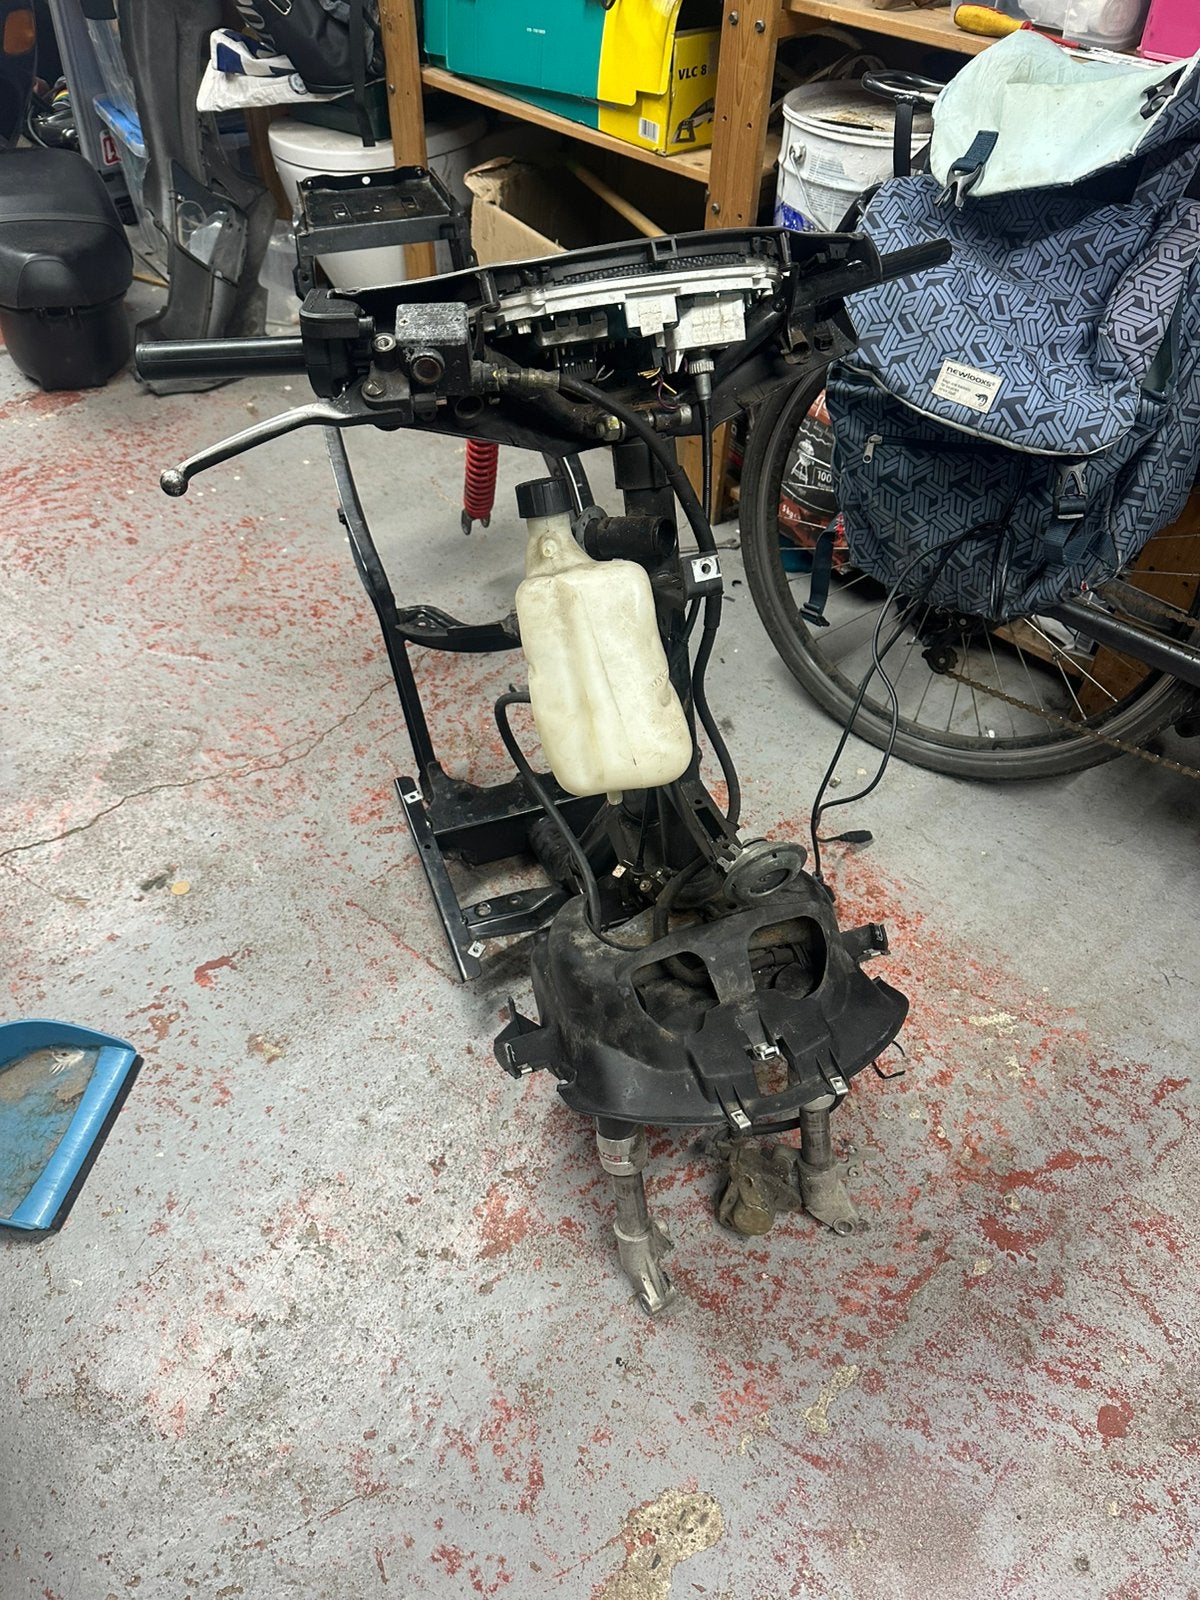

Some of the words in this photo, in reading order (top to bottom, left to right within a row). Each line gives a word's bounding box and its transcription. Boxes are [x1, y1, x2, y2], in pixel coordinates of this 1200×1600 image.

[678, 66, 698, 80] VLC
[700, 64, 707, 76] 8
[817, 470, 832, 483] 100
